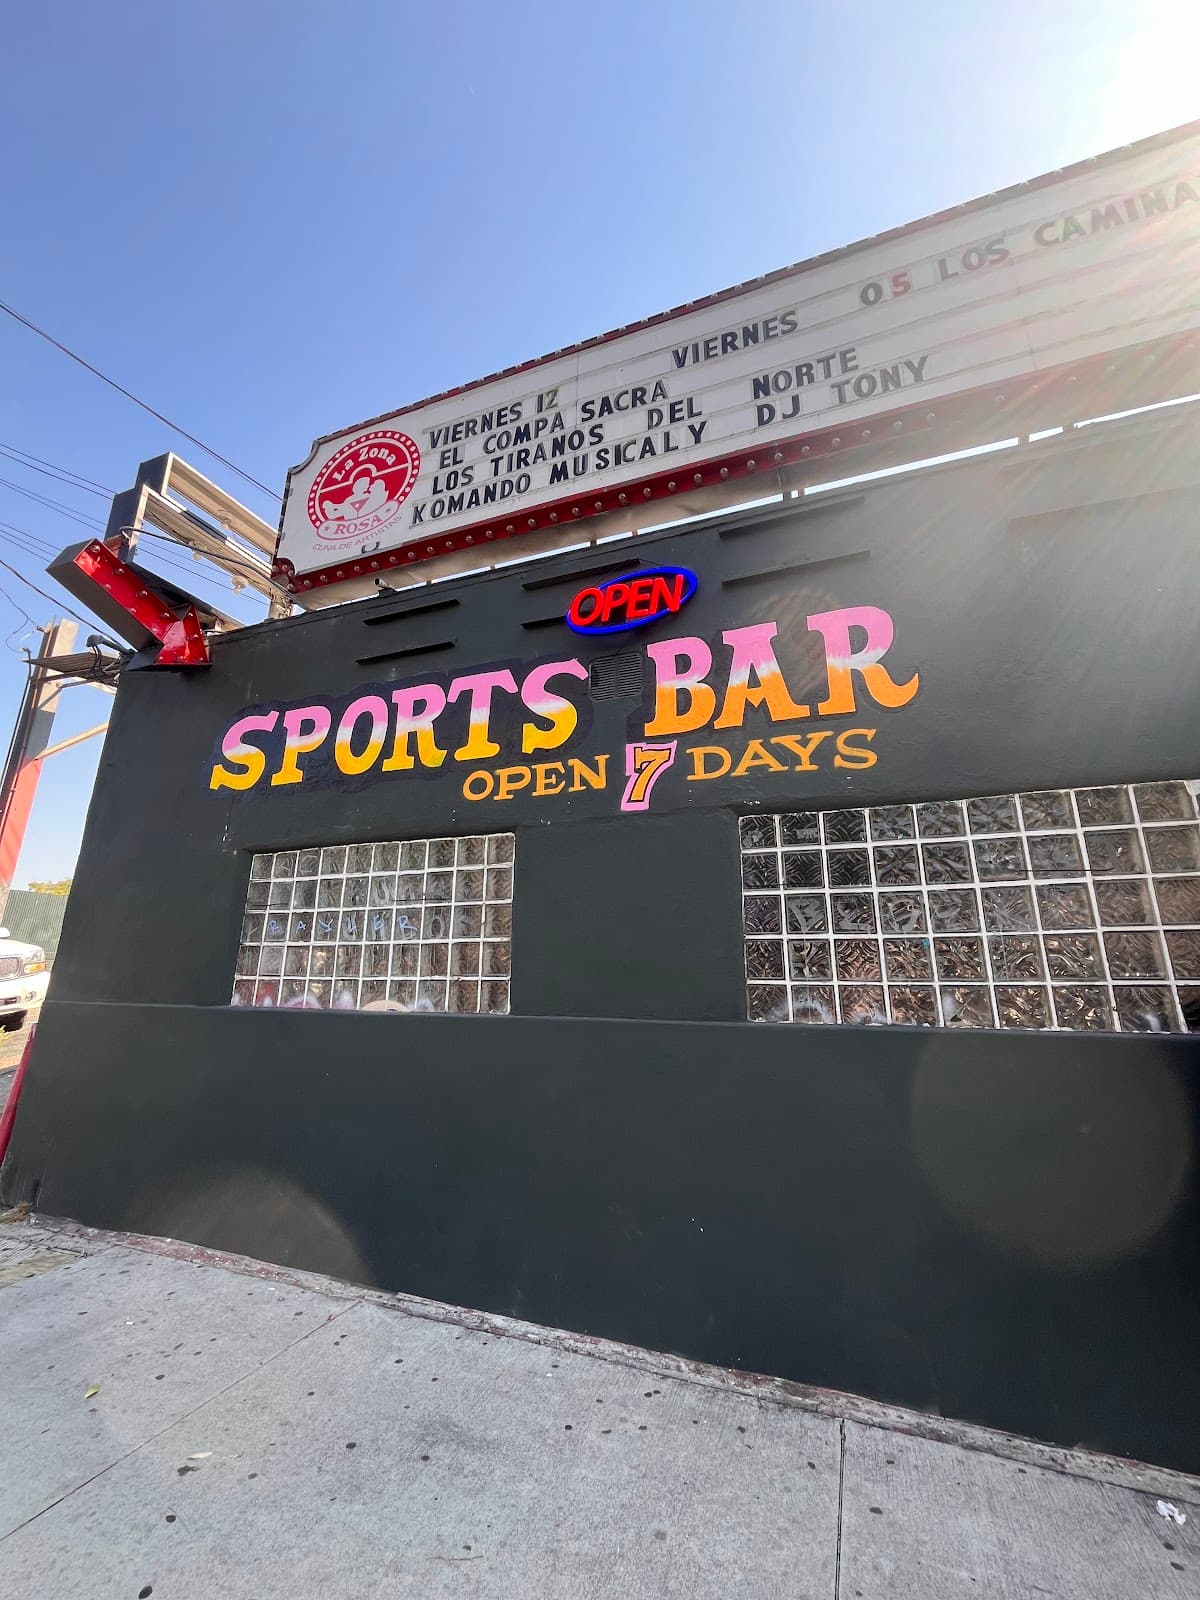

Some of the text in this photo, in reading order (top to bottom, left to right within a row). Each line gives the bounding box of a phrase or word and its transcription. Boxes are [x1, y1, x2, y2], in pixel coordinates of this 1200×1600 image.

[672, 310, 798, 368] VIERNES
[860, 276, 912, 307] 05
[936, 239, 1010, 281] LOS
[412, 472, 531, 525] KOMANDO
[757, 394, 801, 427] DJ
[831, 355, 929, 405] TONY
[430, 388, 559, 449] VIERNES 12
[432, 347, 859, 496] LOS TIRANOS DEL NORTE
[440, 379, 668, 470] EL COMPA SACRA
[332, 446, 397, 481] La Zona
[333, 514, 383, 535] ROSA
[569, 572, 685, 626] OPEN
[209, 605, 920, 791] SPORTS BAR
[462, 728, 878, 812] OPEN 7 DAYS
